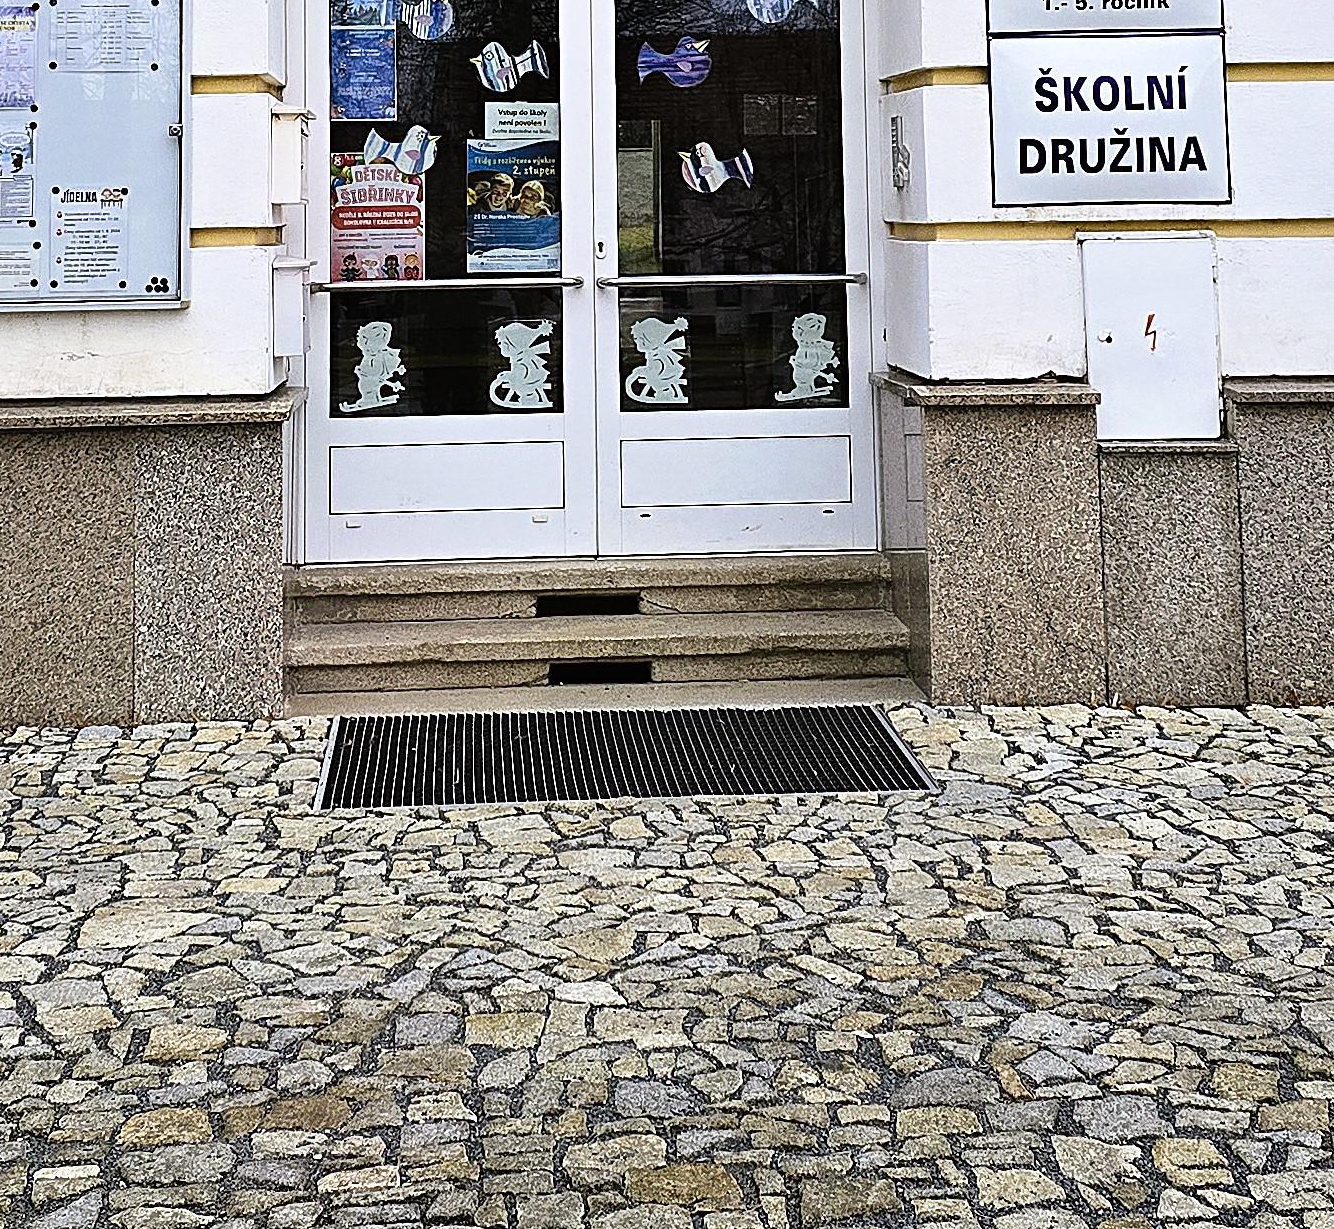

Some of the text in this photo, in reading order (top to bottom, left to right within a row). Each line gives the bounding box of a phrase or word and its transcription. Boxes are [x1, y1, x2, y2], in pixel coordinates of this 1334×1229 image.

[1034, 66, 1189, 113] ŠKOLNÍ
[497, 109, 517, 117] Vstup
[529, 109, 547, 118] školy
[1019, 127, 1207, 174] DRUŽINA
[524, 165, 556, 177] stupeň
